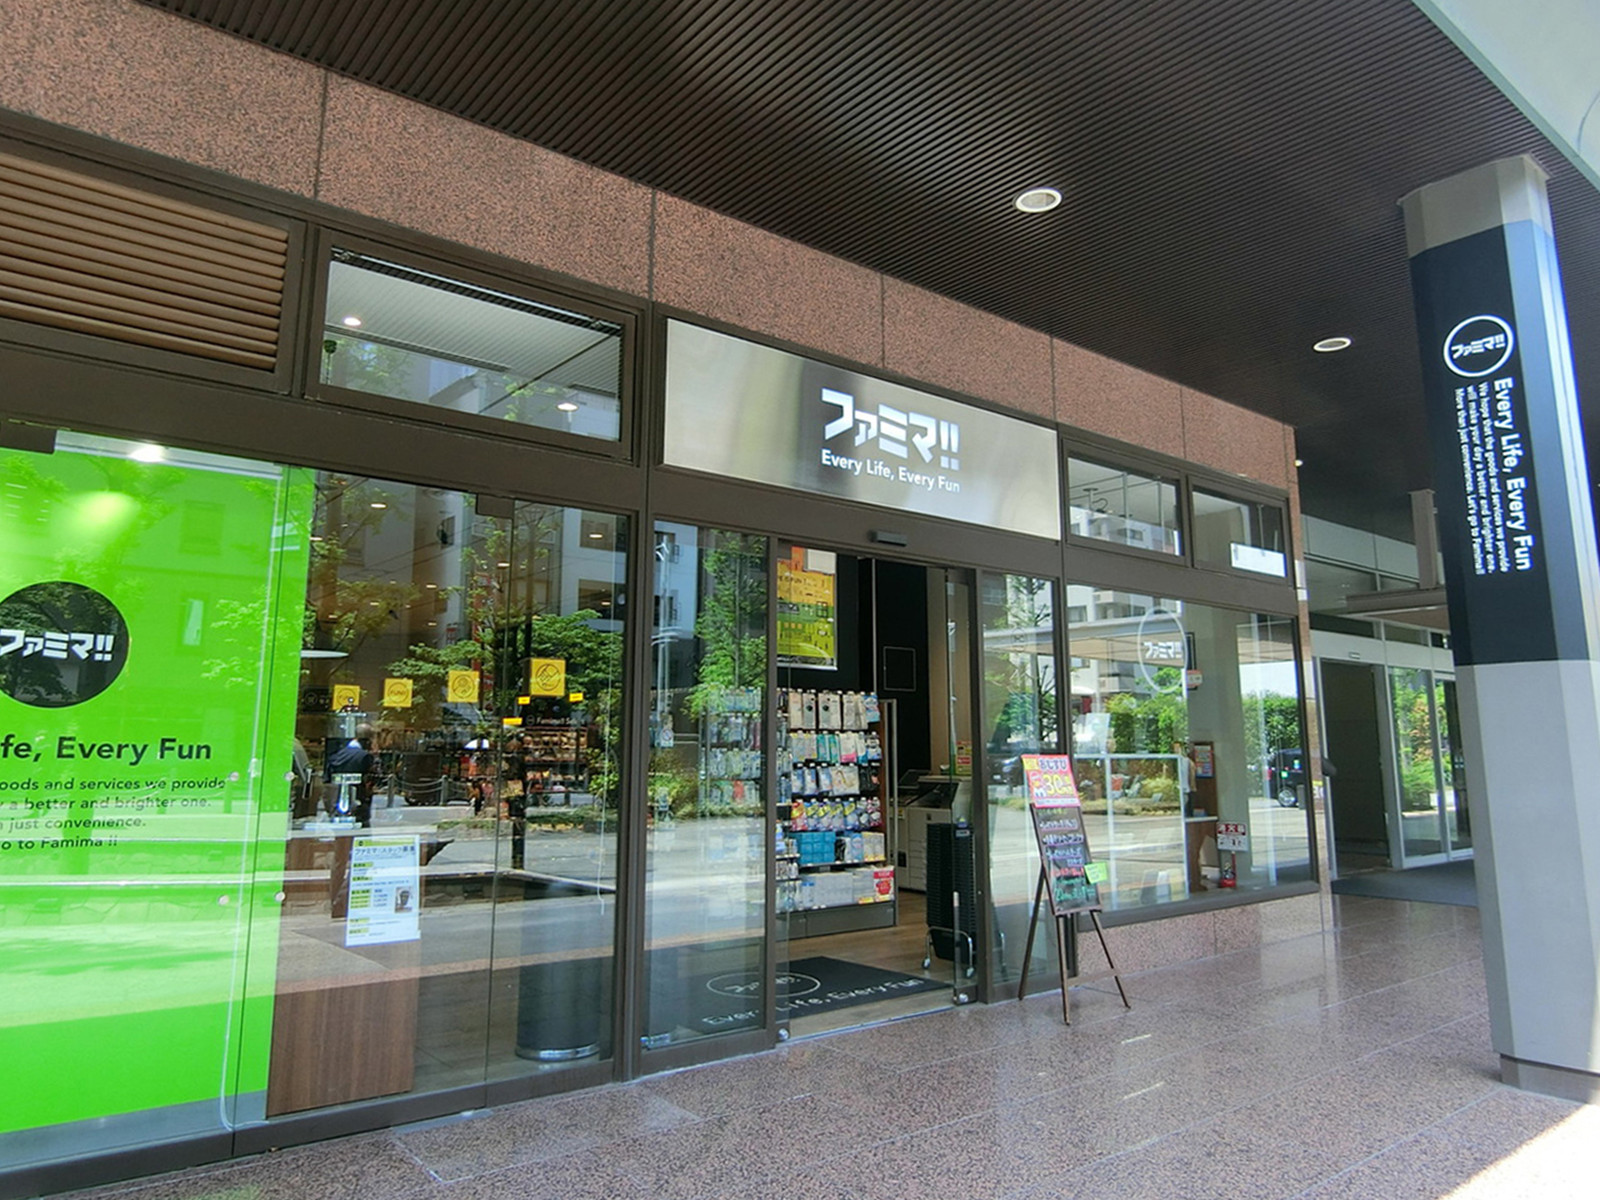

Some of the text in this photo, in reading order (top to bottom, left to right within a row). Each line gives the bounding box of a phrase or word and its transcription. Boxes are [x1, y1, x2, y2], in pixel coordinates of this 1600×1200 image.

[821, 387, 961, 471] ファミマ!!
[821, 448, 961, 493] Every Life, Every Fun
[1485, 452, 1498, 477] goods
[1493, 376, 1534, 570] Every Life, Every Fun
[1490, 478, 1500, 493] and
[0, 628, 115, 661] ファミマ!!
[56, 736, 149, 766] Every
[159, 738, 211, 759] Fun
[44, 777, 75, 790] and
[80, 778, 140, 790] services
[145, 779, 167, 789] we
[171, 777, 226, 792] provide
[24, 797, 76, 810] better
[80, 796, 110, 809] and
[115, 796, 177, 812] brighter
[180, 798, 211, 808] one.
[8, 817, 39, 834] just
[45, 818, 147, 830] convenience.
[19, 839, 36, 850] to
[41, 835, 103, 849] Famima
[703, 1009, 760, 1025] Ever
[885, 977, 925, 991] Fun
